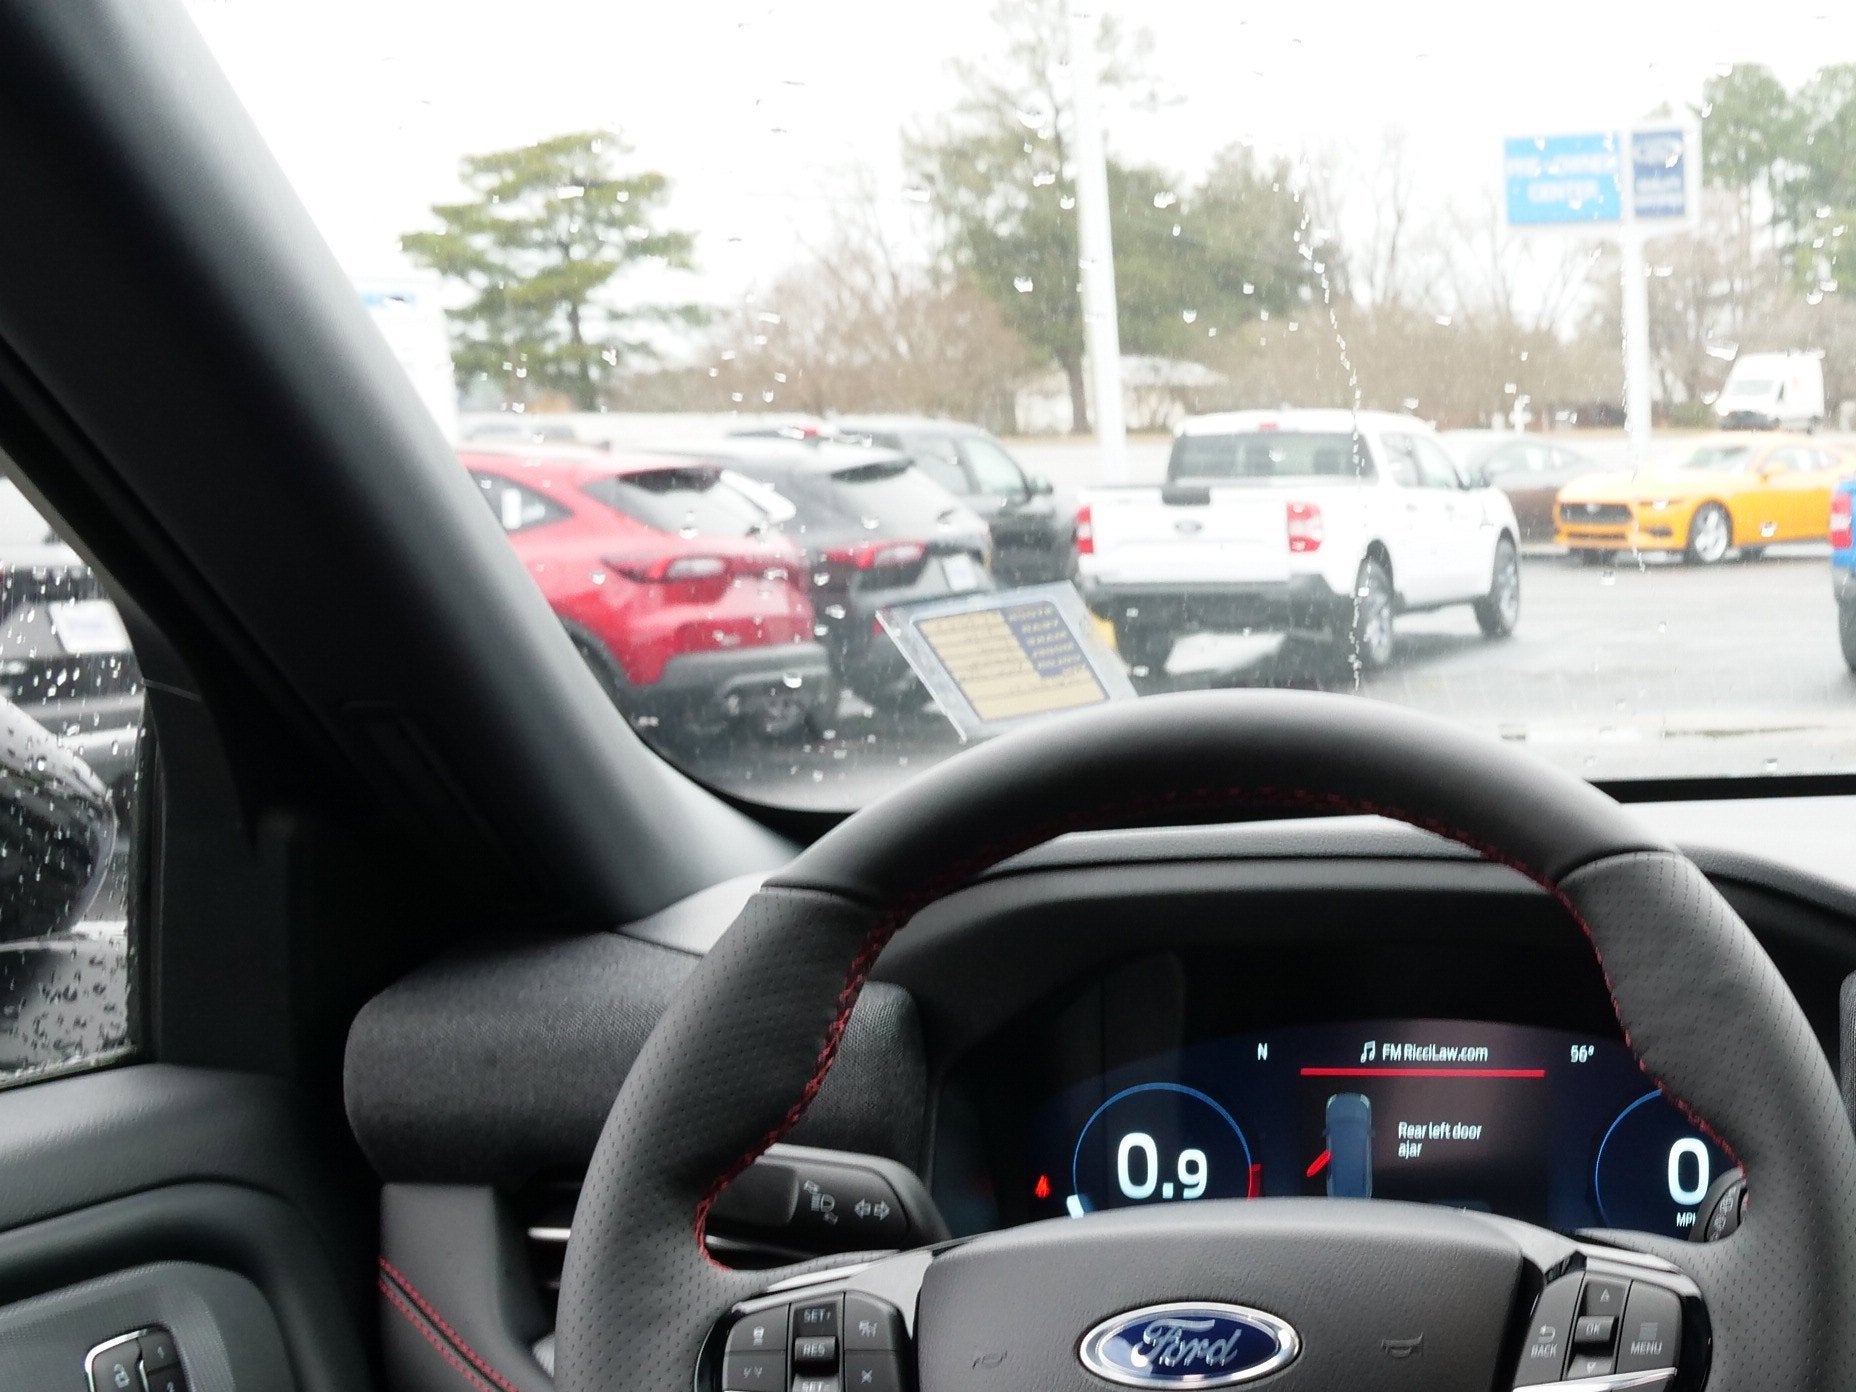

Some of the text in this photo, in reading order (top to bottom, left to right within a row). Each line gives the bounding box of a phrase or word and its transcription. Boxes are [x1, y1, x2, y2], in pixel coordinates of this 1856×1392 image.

[1257, 1043, 1268, 1061] N
[1382, 1043, 1488, 1062] FM RicciLaw.com
[1398, 1122, 1482, 1140] Rear left door
[1398, 1140, 1422, 1158] ajar
[1117, 1132, 1208, 1199] 0.9
[1668, 1137, 1710, 1206] 0
[1586, 1321, 1601, 1336] OK
[1131, 1319, 1242, 1368] Ford
[1530, 1345, 1558, 1359] BACK
[1631, 1341, 1663, 1355] MENU
